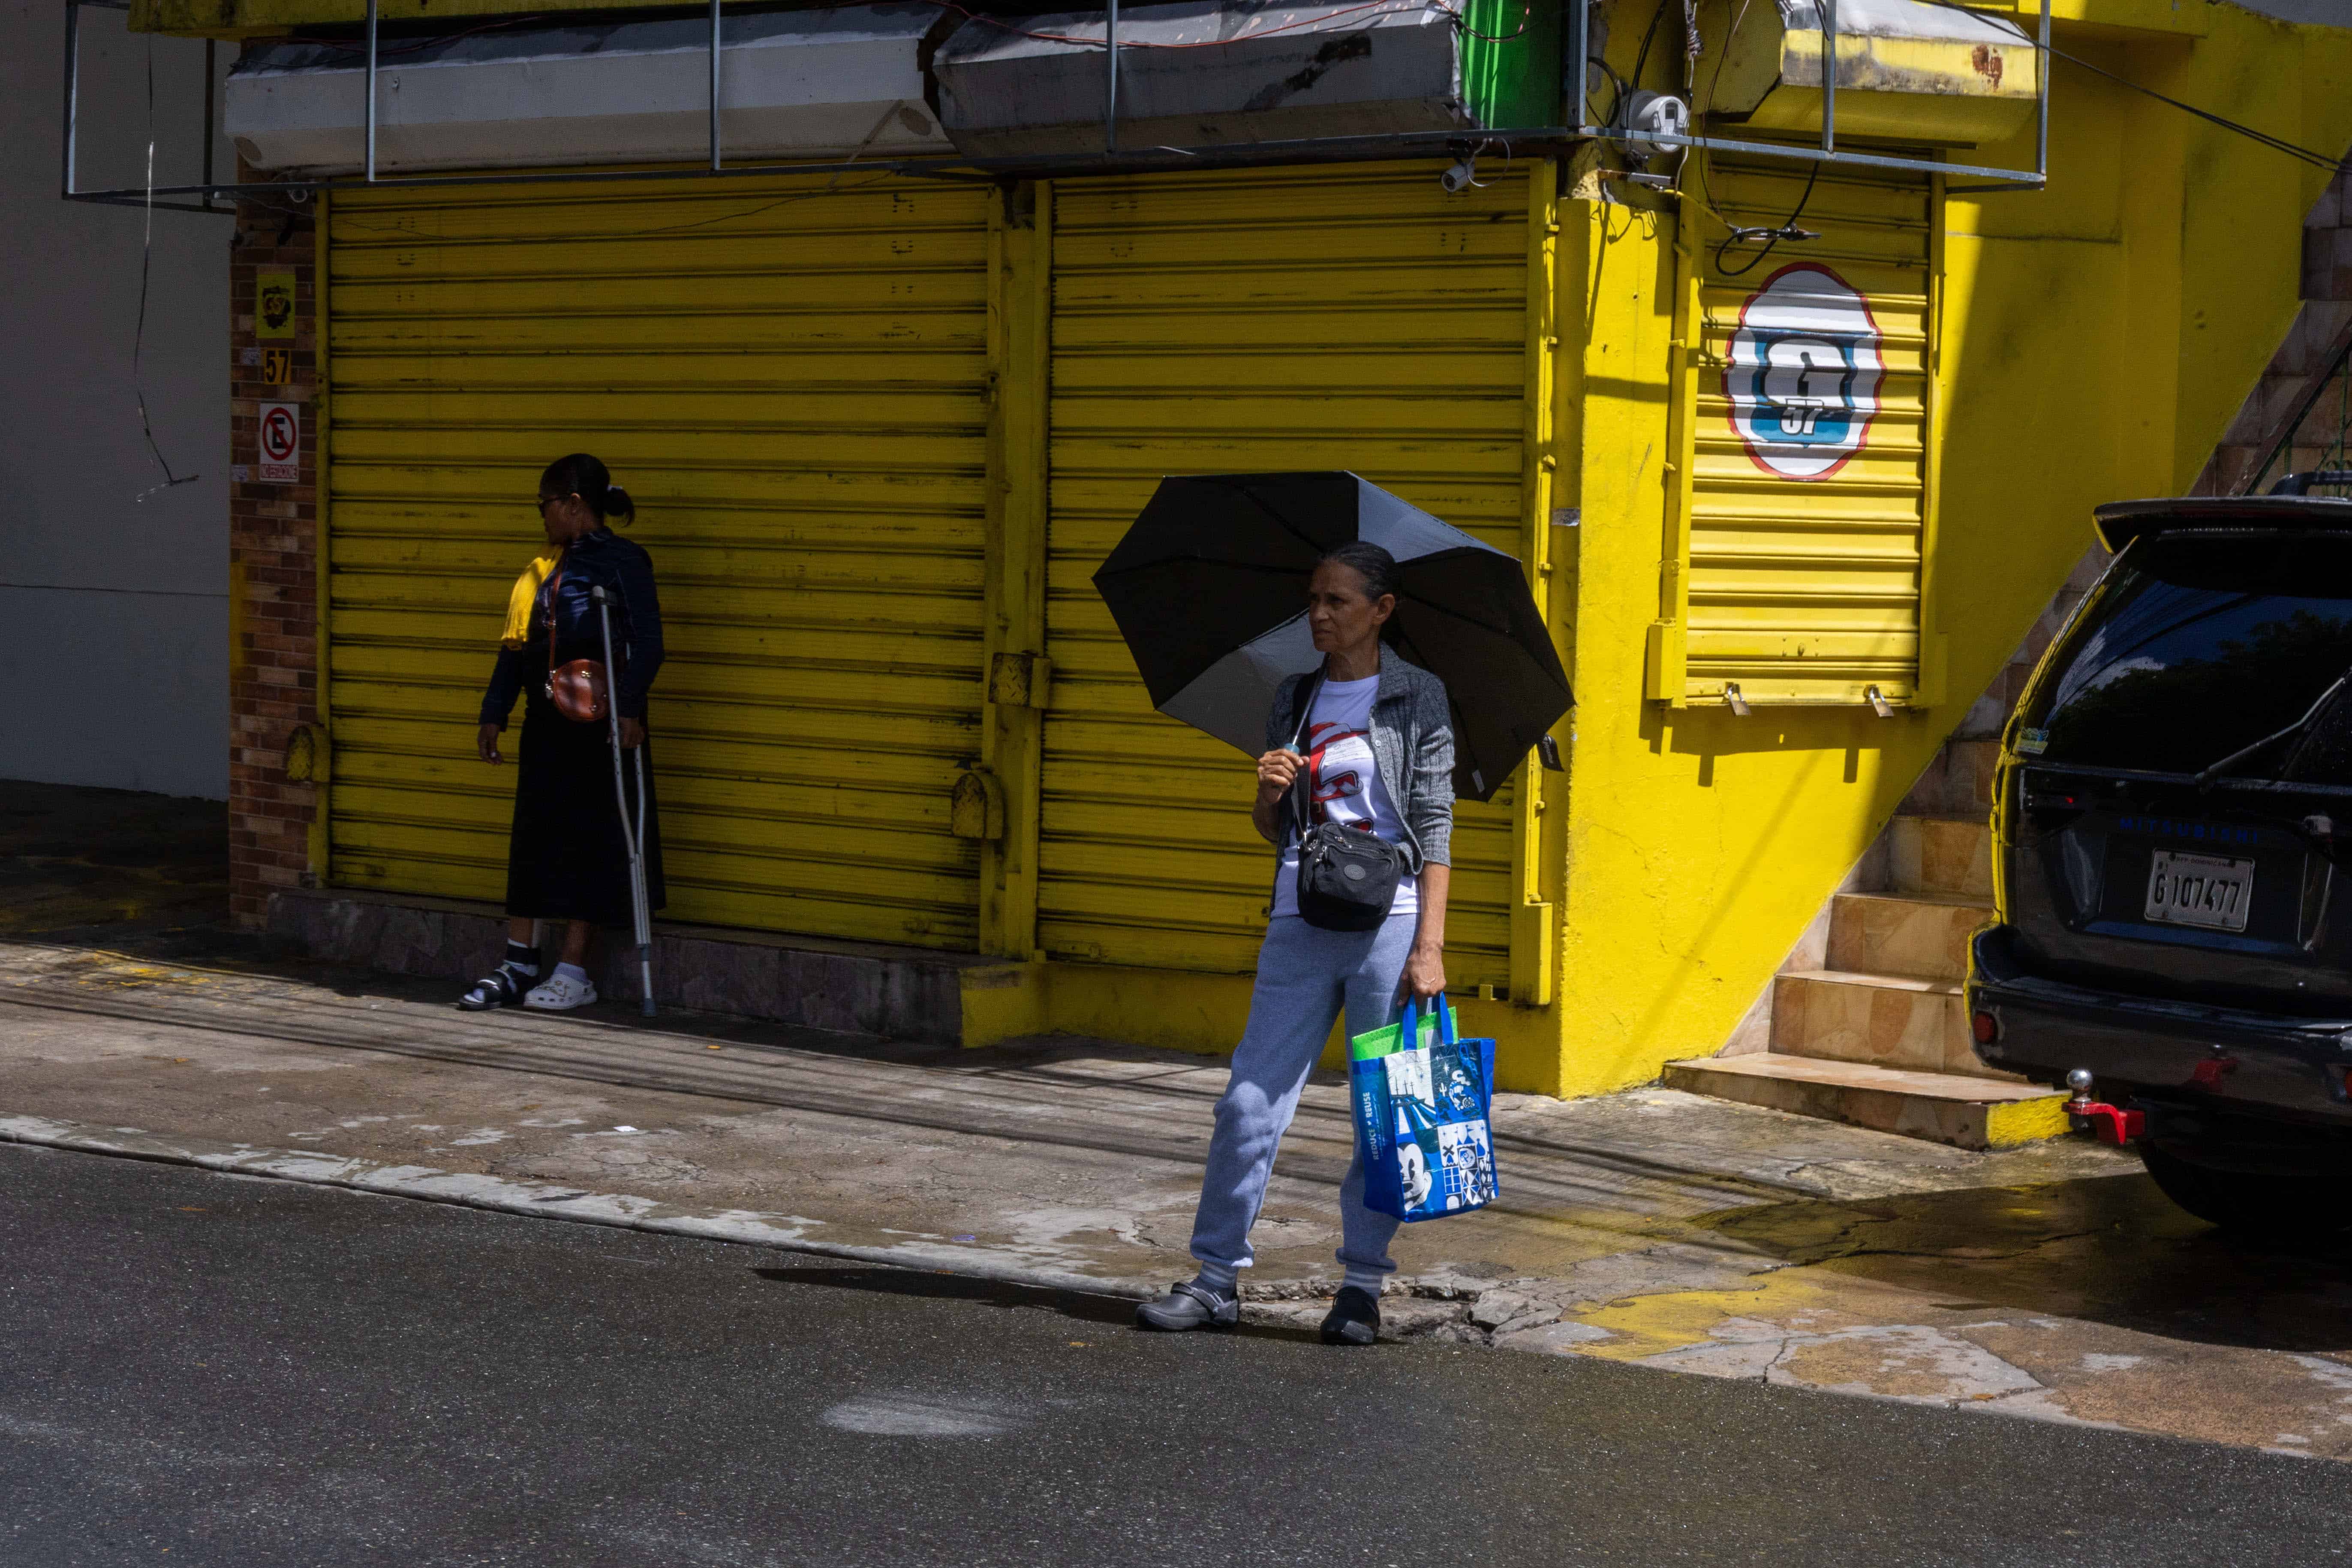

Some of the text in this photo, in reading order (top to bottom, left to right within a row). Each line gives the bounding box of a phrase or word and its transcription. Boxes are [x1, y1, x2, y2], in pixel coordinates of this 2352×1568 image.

[265, 349, 289, 382] 57
[1780, 398, 1825, 436] 57
[2119, 816, 2257, 843] MITSUBISHI
[1362, 1091, 1373, 1117] REUSE
[1368, 1129, 1379, 1160] REDUCE
